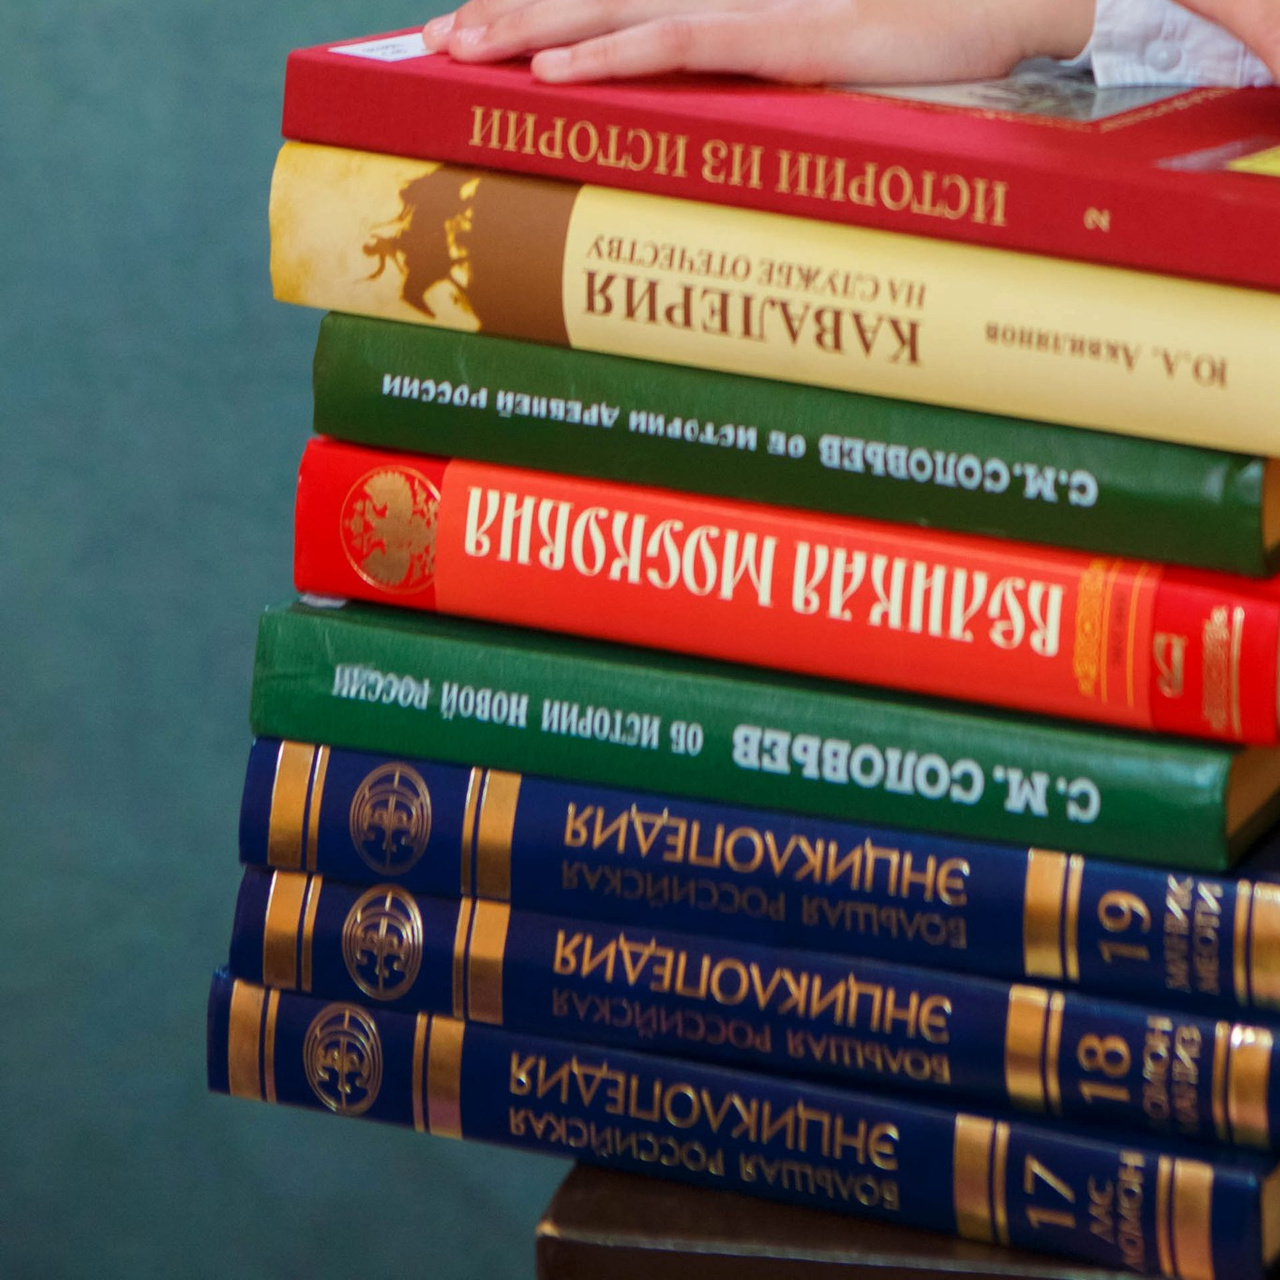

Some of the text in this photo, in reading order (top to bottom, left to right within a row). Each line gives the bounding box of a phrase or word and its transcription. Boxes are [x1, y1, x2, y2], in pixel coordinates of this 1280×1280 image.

[468, 104, 1007, 226] ИСТОРИИ ИЗ ИСТОРИИ
[1082, 206, 1109, 231] 2
[584, 233, 924, 307] НА СЛУЖБЕ ОТЕЧЕСТВУ
[581, 268, 920, 366] КАВАЛЕРИЯ
[381, 372, 487, 408] РОССИИ
[495, 388, 619, 427] ДРЕВНЕЙ
[628, 409, 757, 450] ИСТОРИИ
[463, 485, 777, 607] МОСКОВИЯ
[791, 540, 1063, 656] ВЕЛИКАЯ
[331, 662, 429, 709] РОССИИ
[440, 681, 529, 727] НОВОЙ
[540, 697, 660, 746] ИСТОРИИ
[669, 719, 702, 755] ОБ
[730, 723, 984, 804] СОЛОВЬЕВ
[563, 801, 970, 905] ЭНЦИКЛОПЕДИЯ
[560, 859, 967, 948] БОЛЬШАЯ РОССИЙСКАЯ
[1097, 888, 1153, 964] 19
[551, 929, 951, 1041] ЭНЦИКЛОПЕДИЯ
[550, 986, 951, 1083] БОЛЬШАЯ РОССИЙСКАЯ
[1076, 1031, 1133, 1103] 18
[509, 1050, 899, 1168] ЭНЦИКЛОПЕДИЯ
[507, 1104, 900, 1210] БОЛЬШАЯ РОССИЙСКАЯ
[1023, 1152, 1077, 1228] 17
